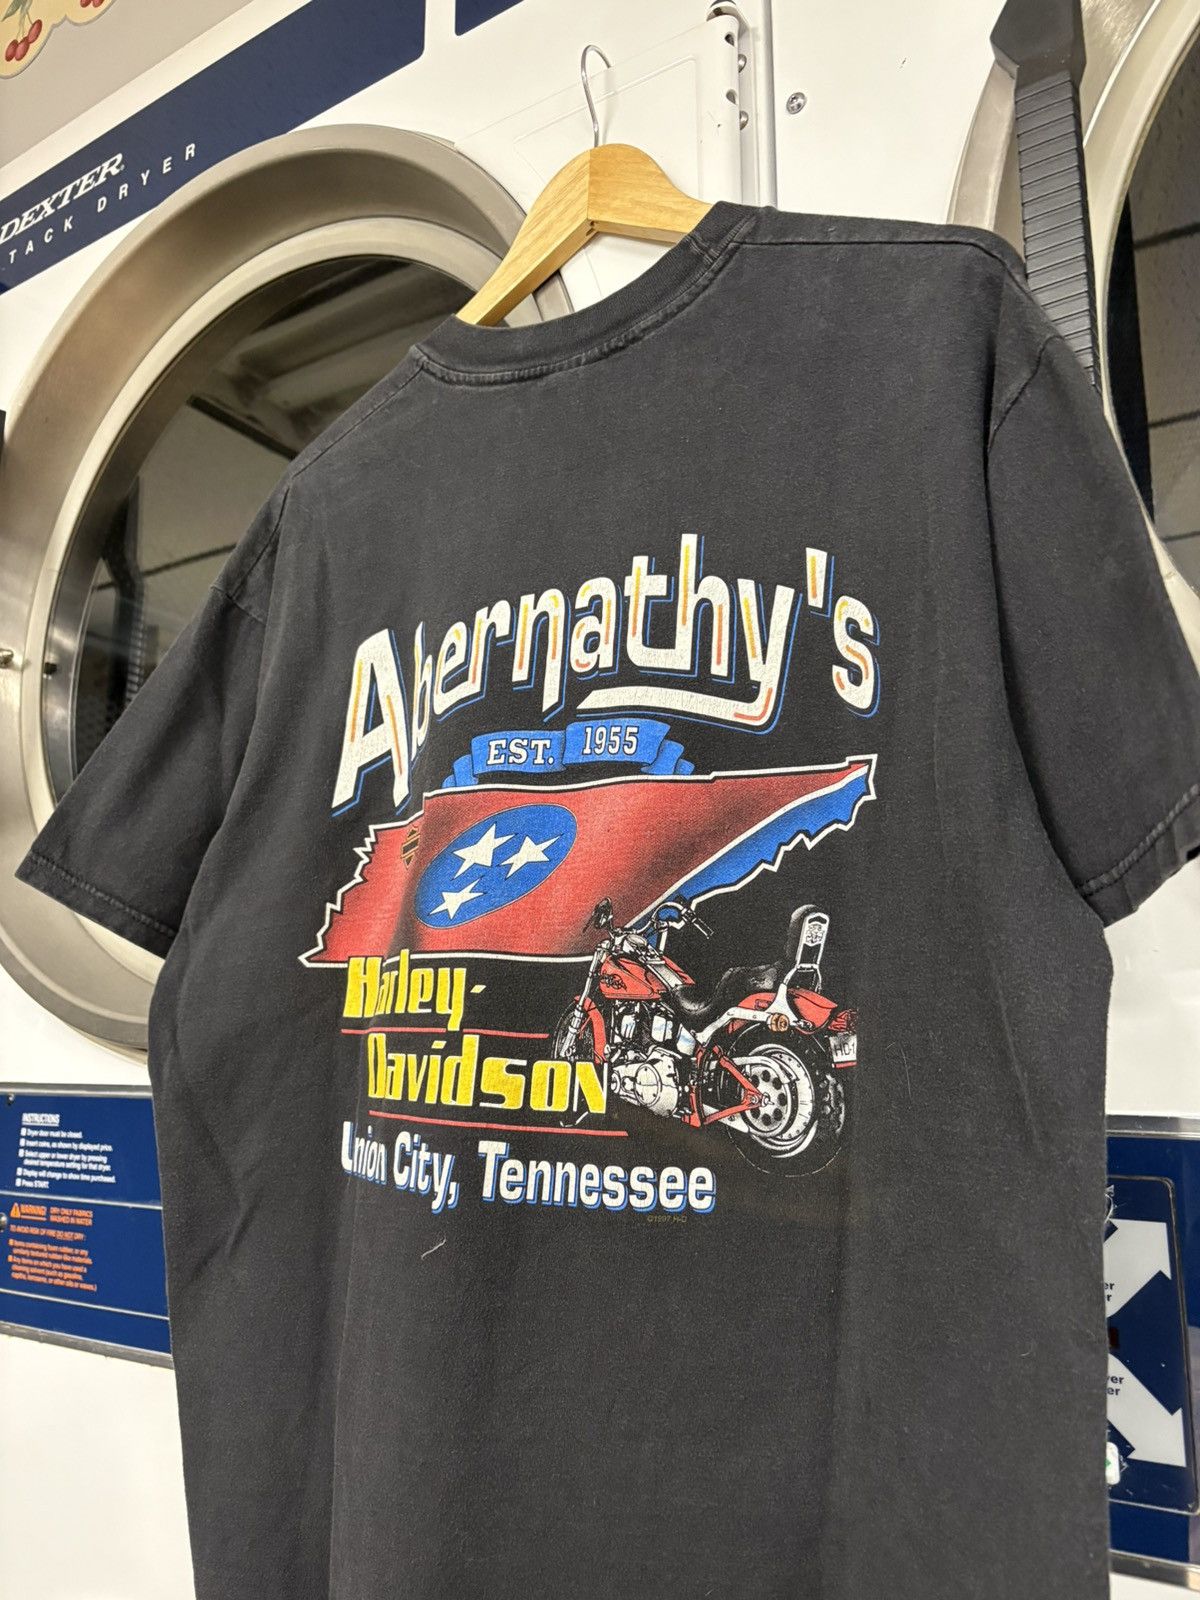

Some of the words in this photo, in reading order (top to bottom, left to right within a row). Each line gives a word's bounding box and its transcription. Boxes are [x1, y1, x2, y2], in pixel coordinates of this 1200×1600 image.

[0, 153, 123, 244] DEXTER
[97, 143, 196, 213] DRYER
[331, 533, 880, 816] Abernathy's
[486, 738, 555, 765] EST.
[583, 726, 638, 755] 1955
[342, 949, 486, 1032] Harley-
[392, 1131, 458, 1214] City,
[477, 1139, 716, 1213] Tennessee
